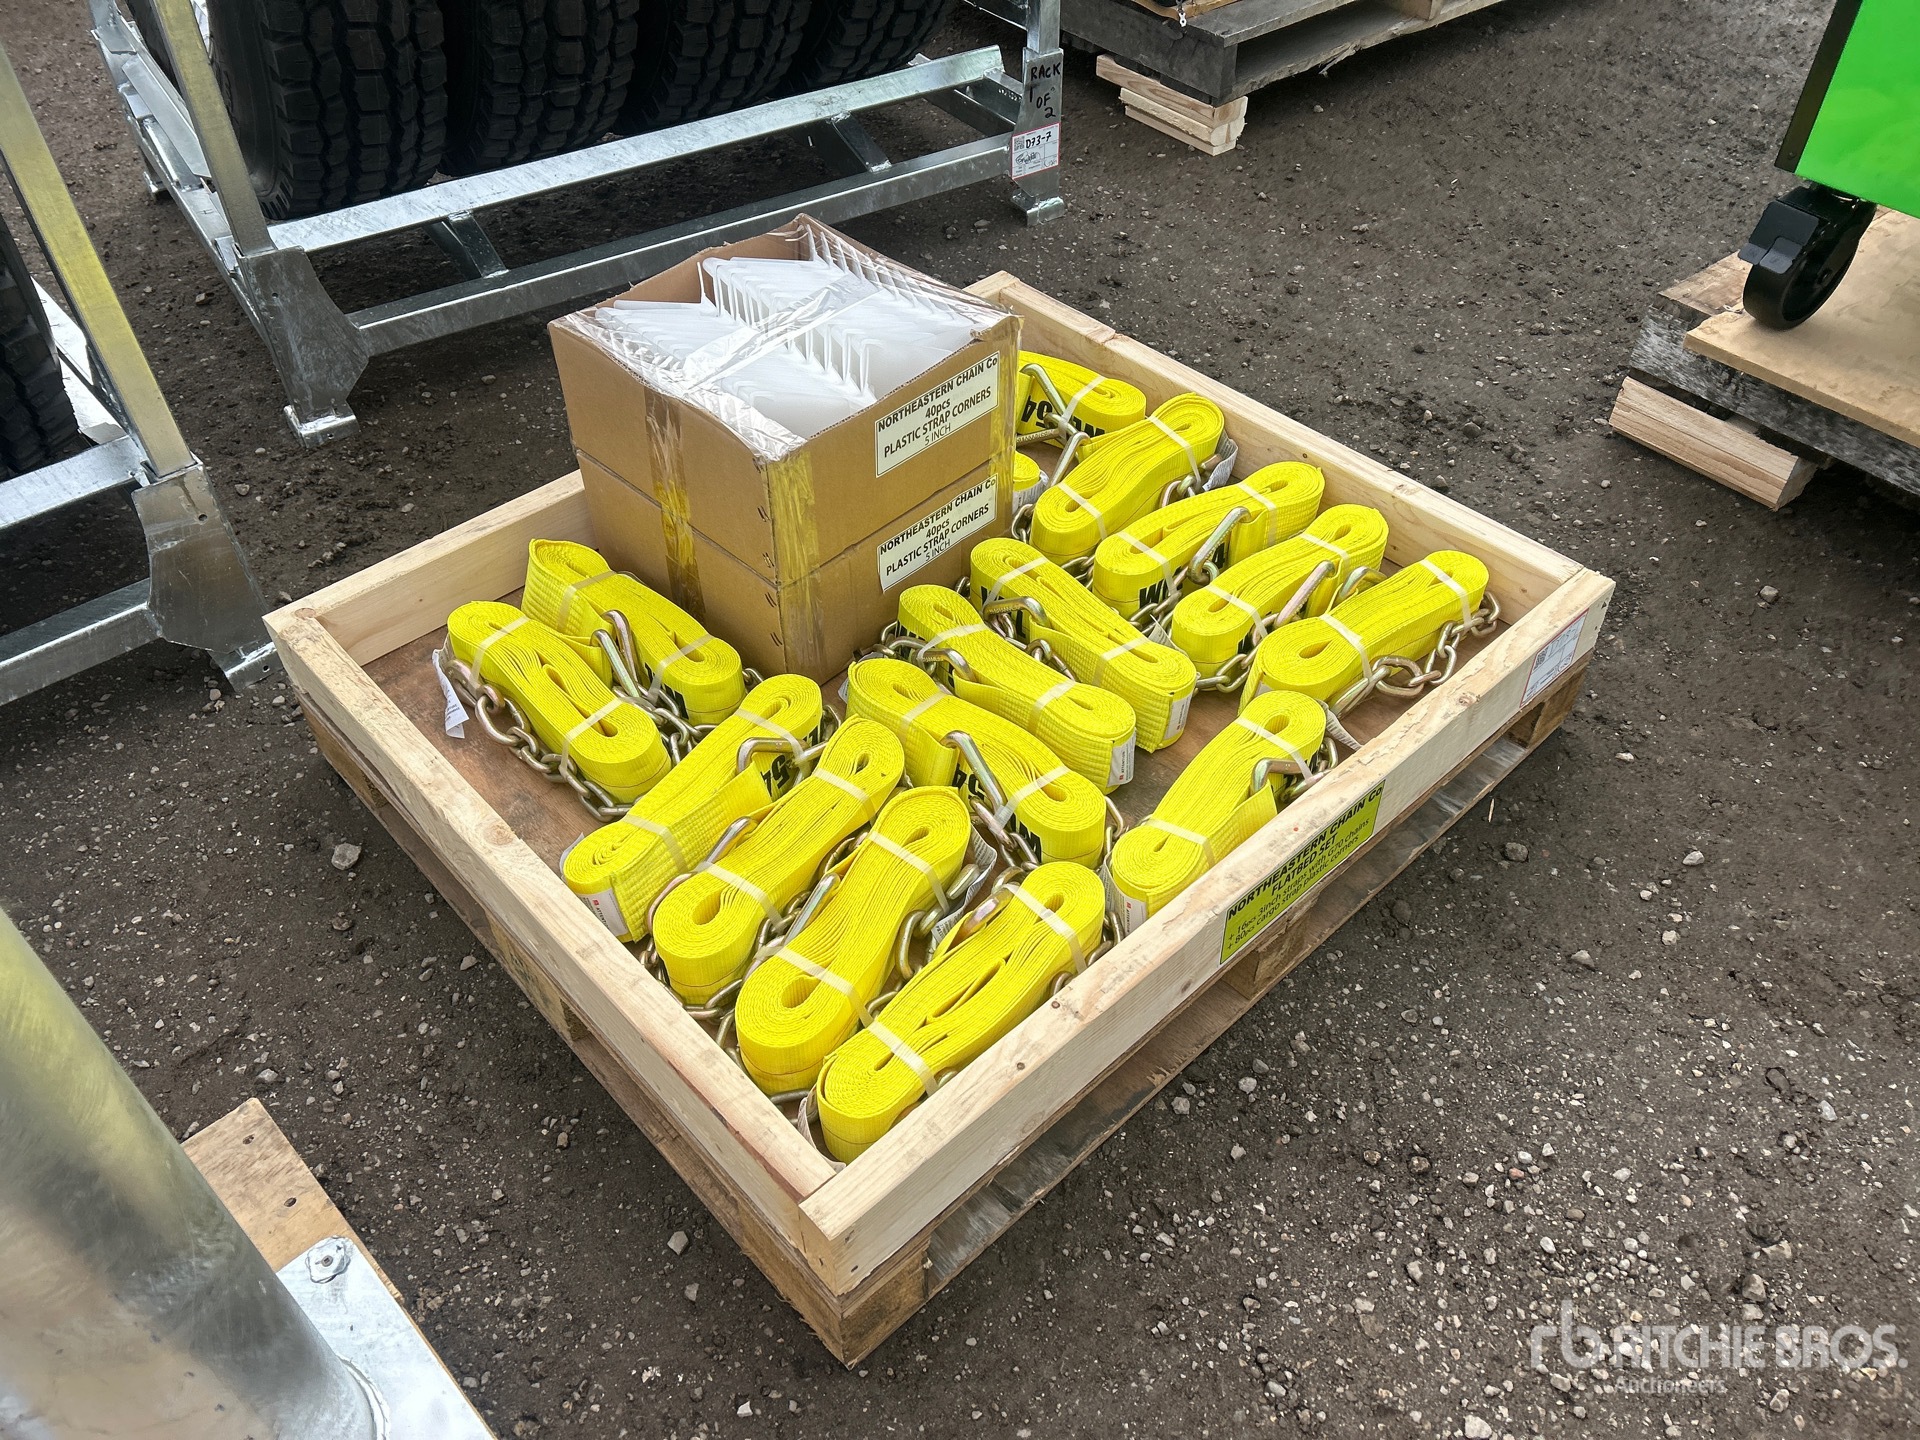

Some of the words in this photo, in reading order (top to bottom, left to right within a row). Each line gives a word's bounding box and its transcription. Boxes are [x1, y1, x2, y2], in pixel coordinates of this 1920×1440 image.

[1030, 62, 1061, 81] RACK
[1036, 92, 1051, 109] OF
[1044, 106, 1056, 119] 2
[878, 382, 954, 433] NORTHEASTERN
[956, 362, 984, 387] CHAIN
[986, 357, 998, 369] Co
[884, 427, 921, 458] PLASTIC
[922, 410, 950, 435] STRAP
[952, 386, 992, 418] CORNERS
[925, 399, 951, 419] 40pcs
[924, 437, 930, 447] 5
[931, 422, 951, 443] INCH
[880, 502, 953, 556] NORTHEASTERN
[955, 485, 983, 508] CHAIN
[985, 479, 996, 490] Co
[886, 546, 922, 577] PLASTIC
[923, 529, 950, 553] STRAP
[951, 503, 989, 534] CORNERS
[926, 519, 950, 538] 40pcs
[925, 553, 931, 562] 5
[931, 540, 951, 560] INCH
[1228, 831, 1327, 921] NORTHEASTERN
[1330, 798, 1366, 834] CHAIN
[1256, 903, 1281, 926] cargo
[1282, 883, 1303, 905] strap
[1303, 859, 1329, 888] plastic
[1330, 834, 1360, 862] corners
[1258, 893, 1282, 915] 3inch
[1283, 871, 1308, 895] straps
[1309, 854, 1327, 873] with
[1327, 838, 1344, 857] G70
[1344, 818, 1370, 843] chains
[1271, 851, 1318, 896] FLATBED
[1318, 832, 1338, 856] SET
